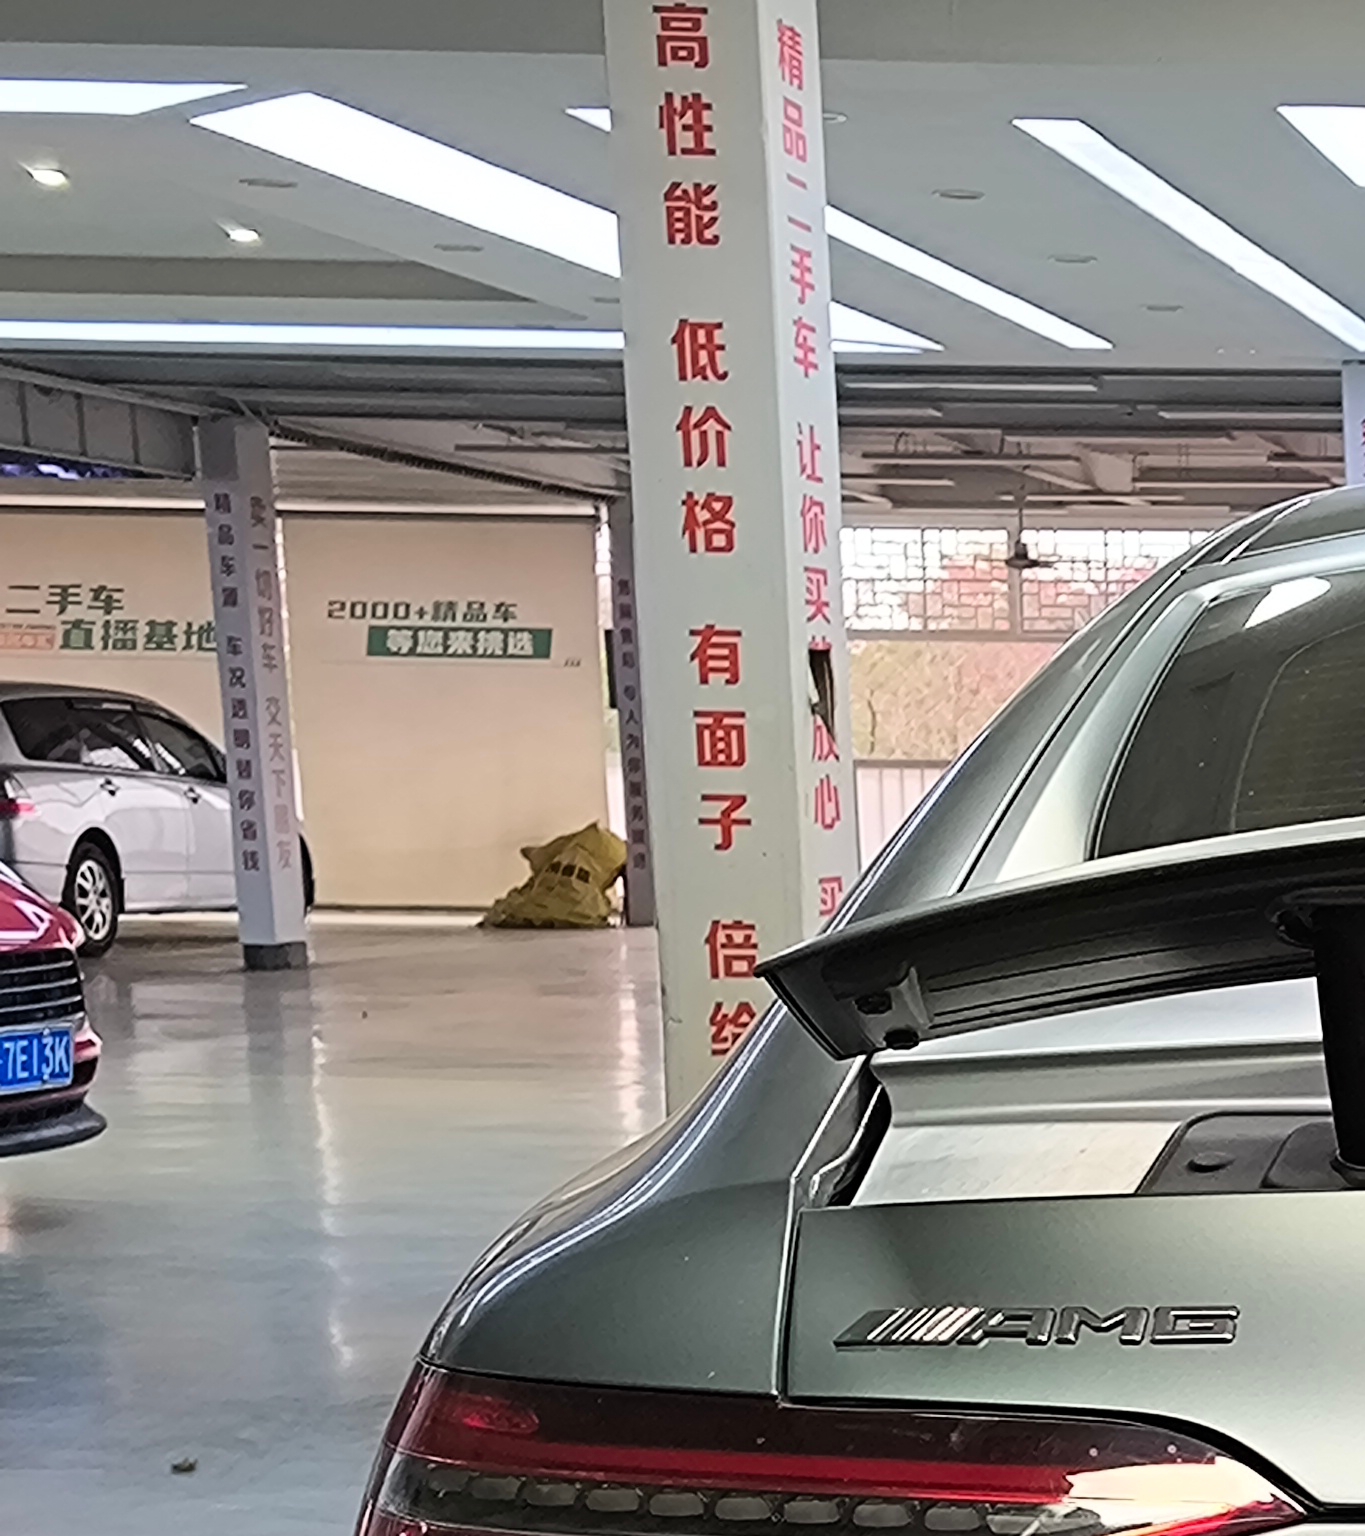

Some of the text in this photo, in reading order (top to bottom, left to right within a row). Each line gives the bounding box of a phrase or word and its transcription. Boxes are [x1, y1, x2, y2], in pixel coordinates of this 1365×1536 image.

[652, 2, 721, 247] 高性能
[775, 18, 820, 378] 精品二手车
[670, 318, 736, 555] 低价格
[6, 584, 124, 616] 二手车
[327, 600, 518, 623] 2000+精品车
[60, 619, 217, 651] 直播基地
[386, 629, 534, 656] 等您来挑选
[796, 421, 841, 830] 让你买放心
[689, 624, 752, 851] 有面子
[3, 1036, 69, 1080] 7E13K
[957, 1305, 1240, 1346] AMG
